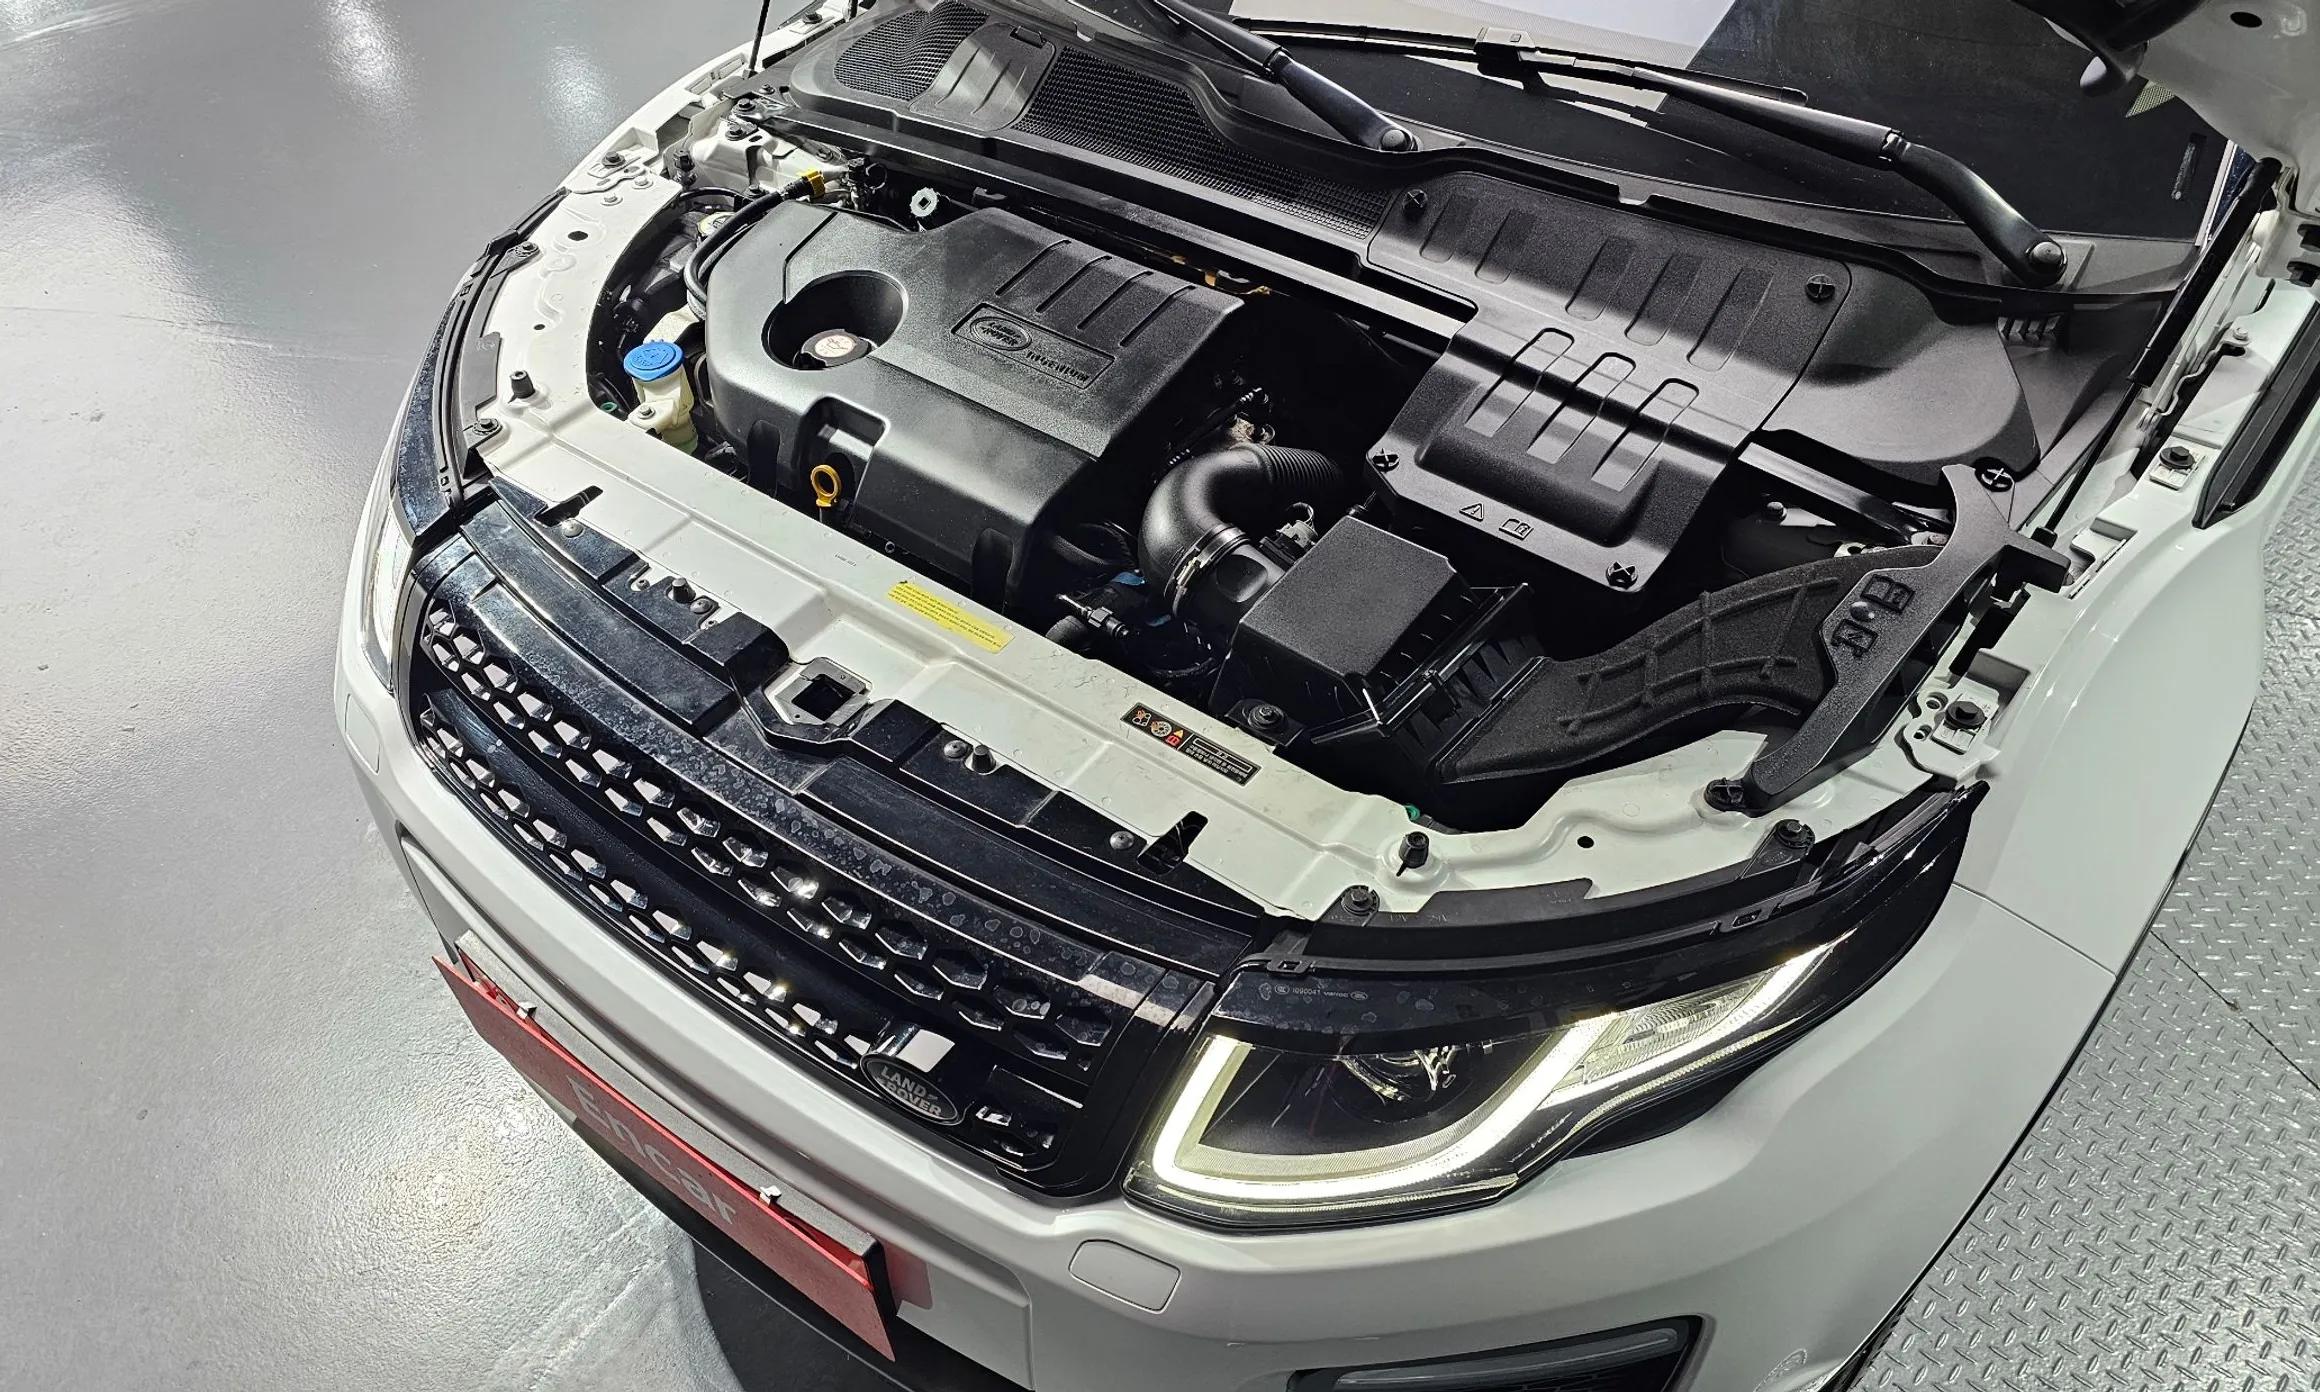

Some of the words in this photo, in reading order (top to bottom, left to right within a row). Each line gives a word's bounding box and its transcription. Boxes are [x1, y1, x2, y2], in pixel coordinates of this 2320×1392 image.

[880, 1066, 927, 1097] LAND
[886, 1080, 942, 1117] ROVER
[565, 1074, 736, 1225] Encar
